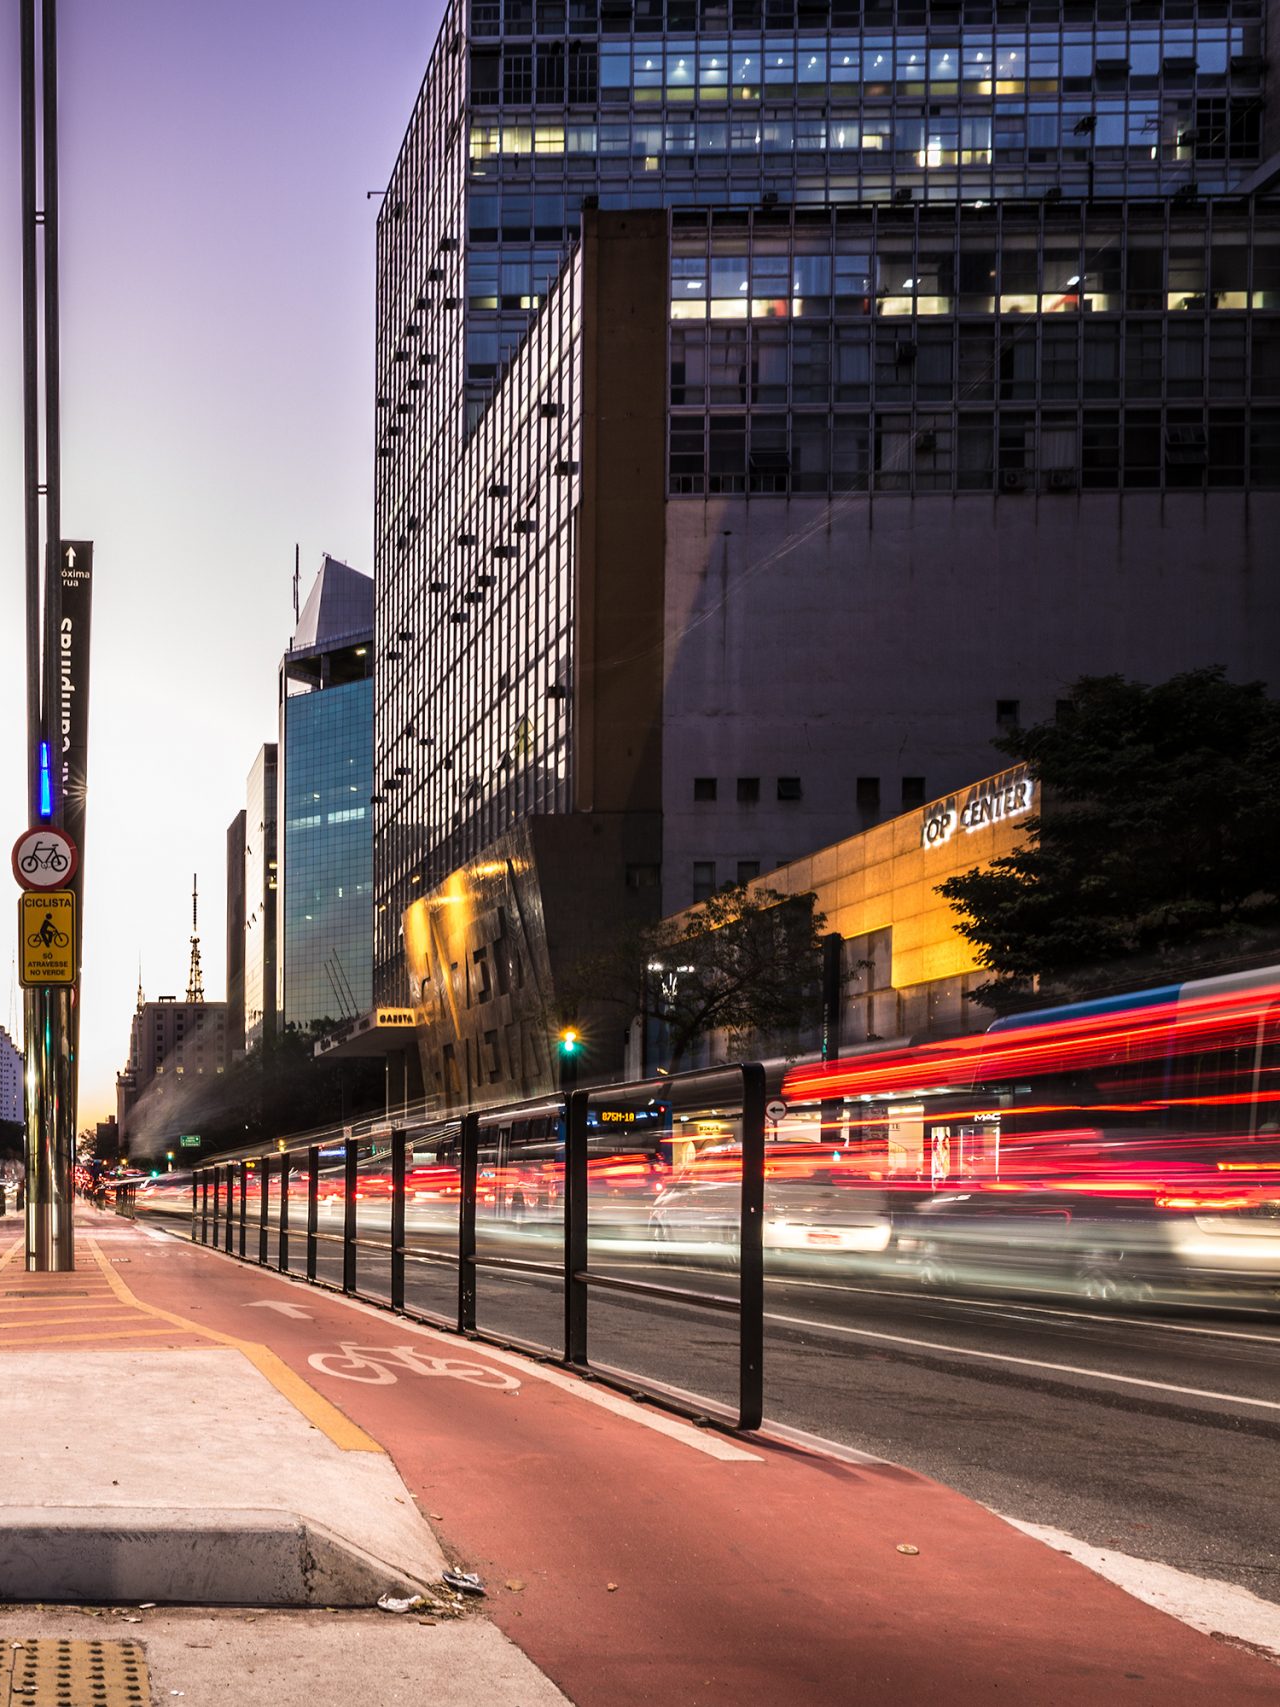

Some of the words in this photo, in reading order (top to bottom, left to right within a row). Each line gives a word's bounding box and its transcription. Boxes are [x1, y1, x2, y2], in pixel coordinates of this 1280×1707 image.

[63, 579, 79, 587] rua
[919, 812, 952, 848] TOP
[960, 782, 1027, 828] CENTER
[24, 898, 72, 908] CICLISTA
[42, 952, 53, 960] SÓ
[42, 969, 66, 977] VERDE
[379, 1014, 414, 1024] GAZETA
